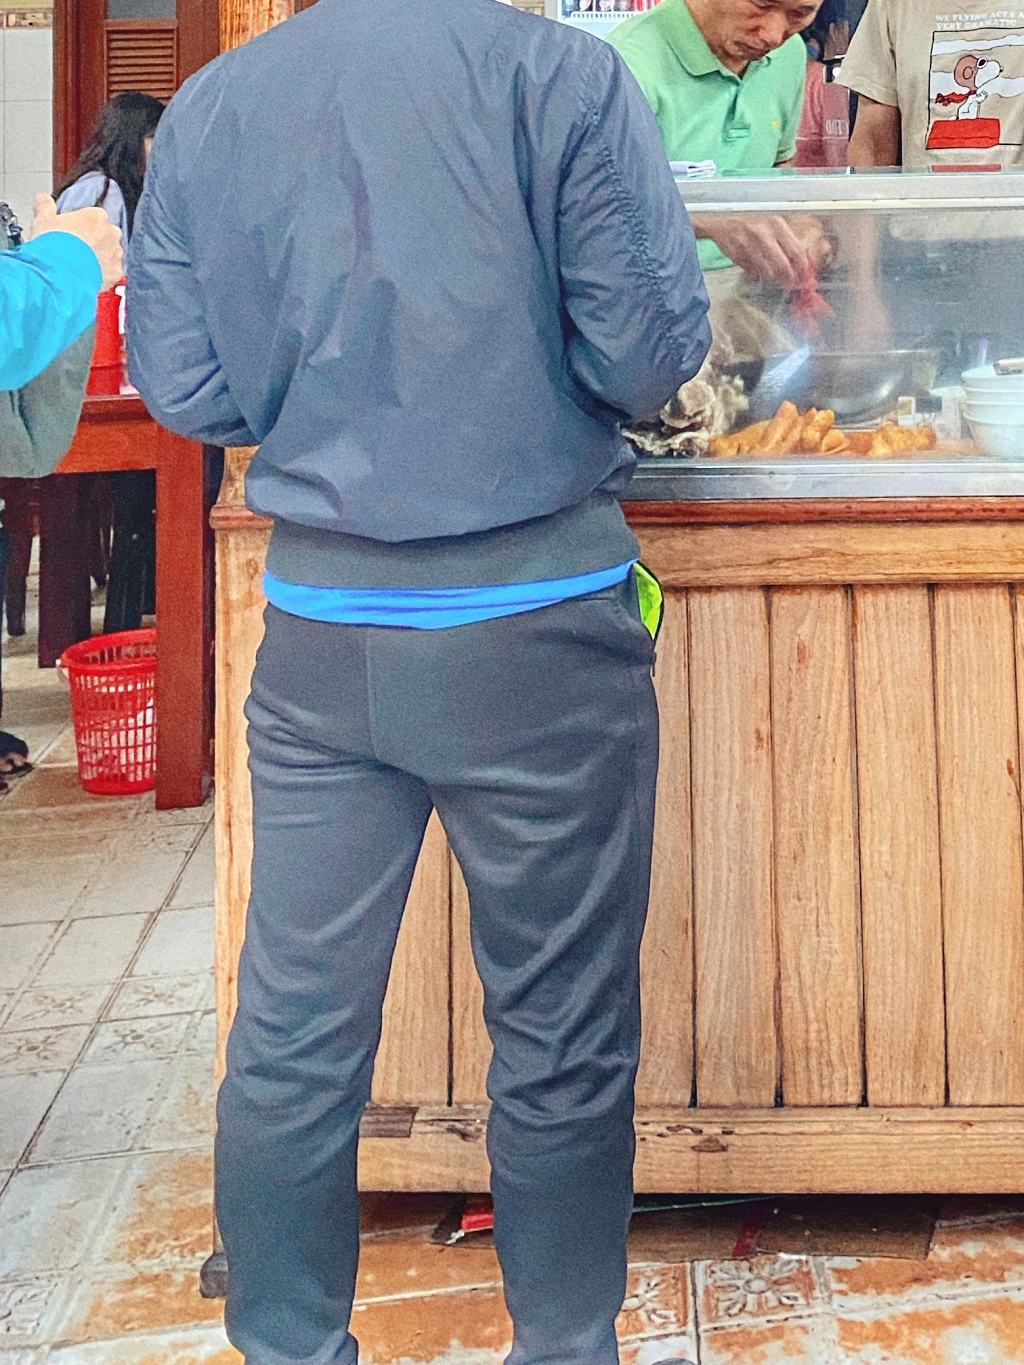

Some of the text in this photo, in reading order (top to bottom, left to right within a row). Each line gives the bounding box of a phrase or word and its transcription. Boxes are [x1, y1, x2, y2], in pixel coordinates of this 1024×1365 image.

[935, 14, 950, 22] WE
[952, 12, 988, 22] FLYING
[989, 10, 1016, 19] ACES
[936, 19, 1017, 30] VERY DRAMATIC
